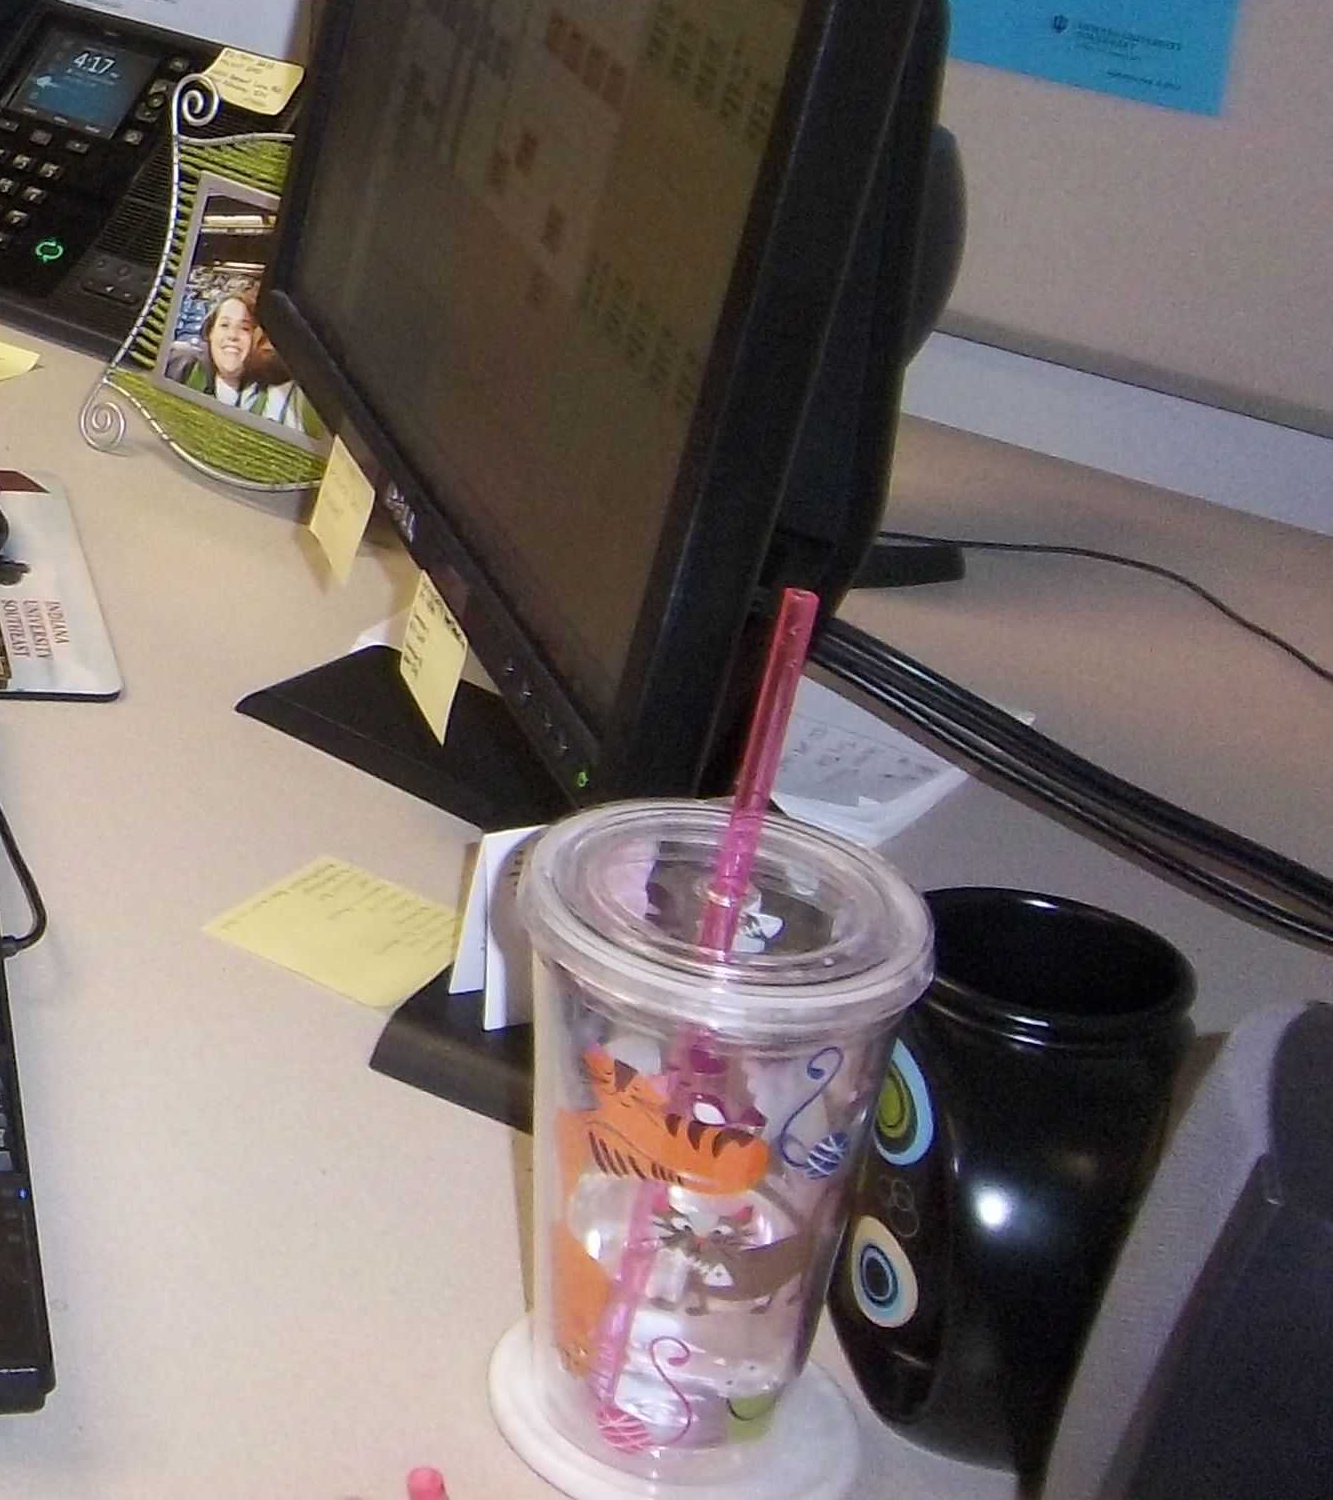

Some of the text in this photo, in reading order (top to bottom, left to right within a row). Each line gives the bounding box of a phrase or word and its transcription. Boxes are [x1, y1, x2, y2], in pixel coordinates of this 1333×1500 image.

[72, 51, 116, 75] 4:17
[0, 599, 31, 658] SOUTHEAST
[22, 599, 53, 659] UNIVERSITY
[44, 600, 71, 644] INDIANA
